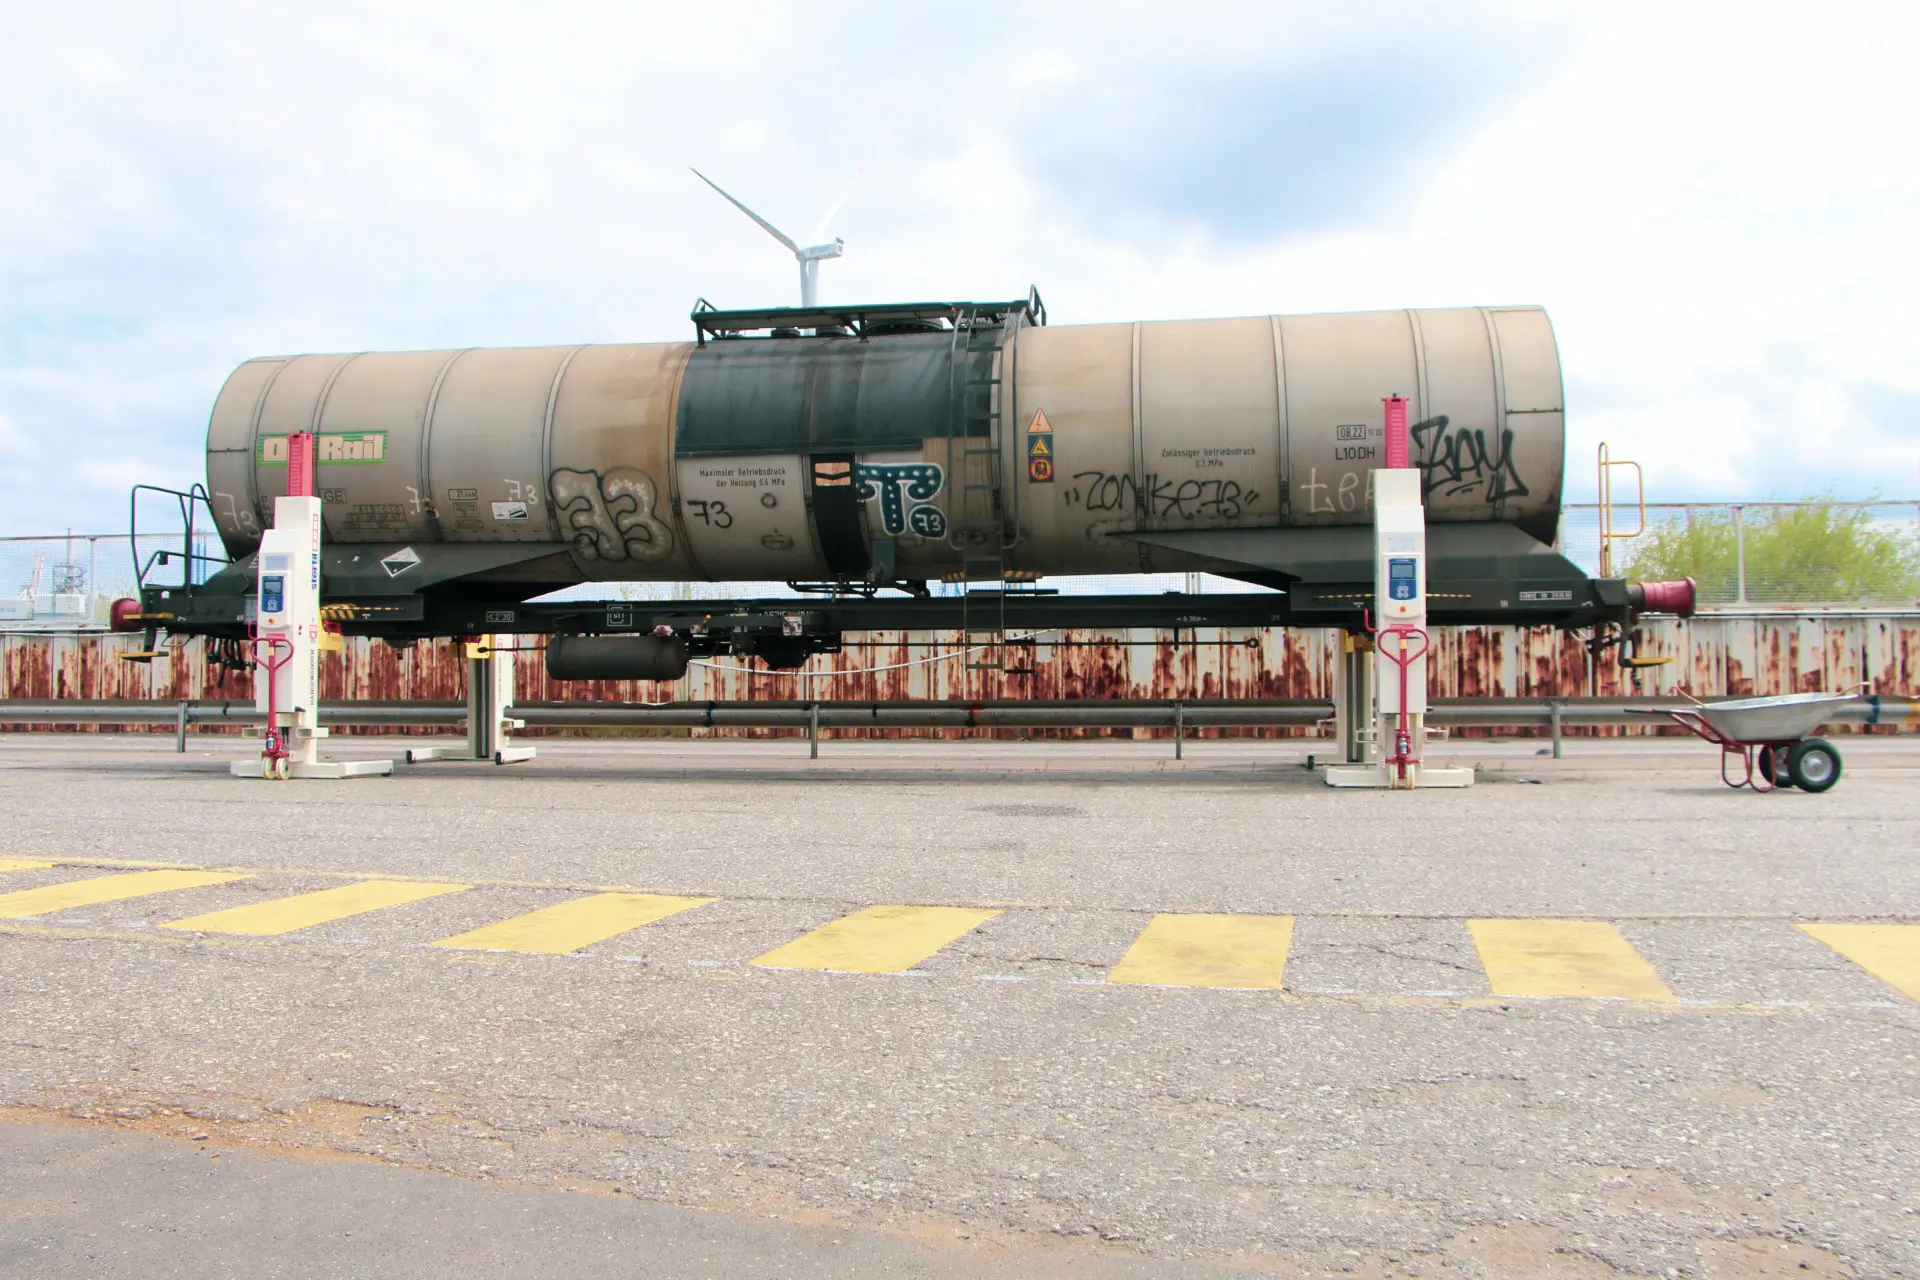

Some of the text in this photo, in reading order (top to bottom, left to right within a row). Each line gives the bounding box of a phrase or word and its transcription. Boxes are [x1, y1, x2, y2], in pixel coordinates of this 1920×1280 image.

[318, 434, 384, 461] Rail
[1161, 448, 1256, 458] Zulässiger Betriebsdruck
[700, 468, 786, 477] Maximaler Betriebsdruck
[730, 479, 757, 488] Heizung
[771, 478, 785, 486] MPa
[686, 500, 734, 529] 73
[915, 514, 941, 532] 73
